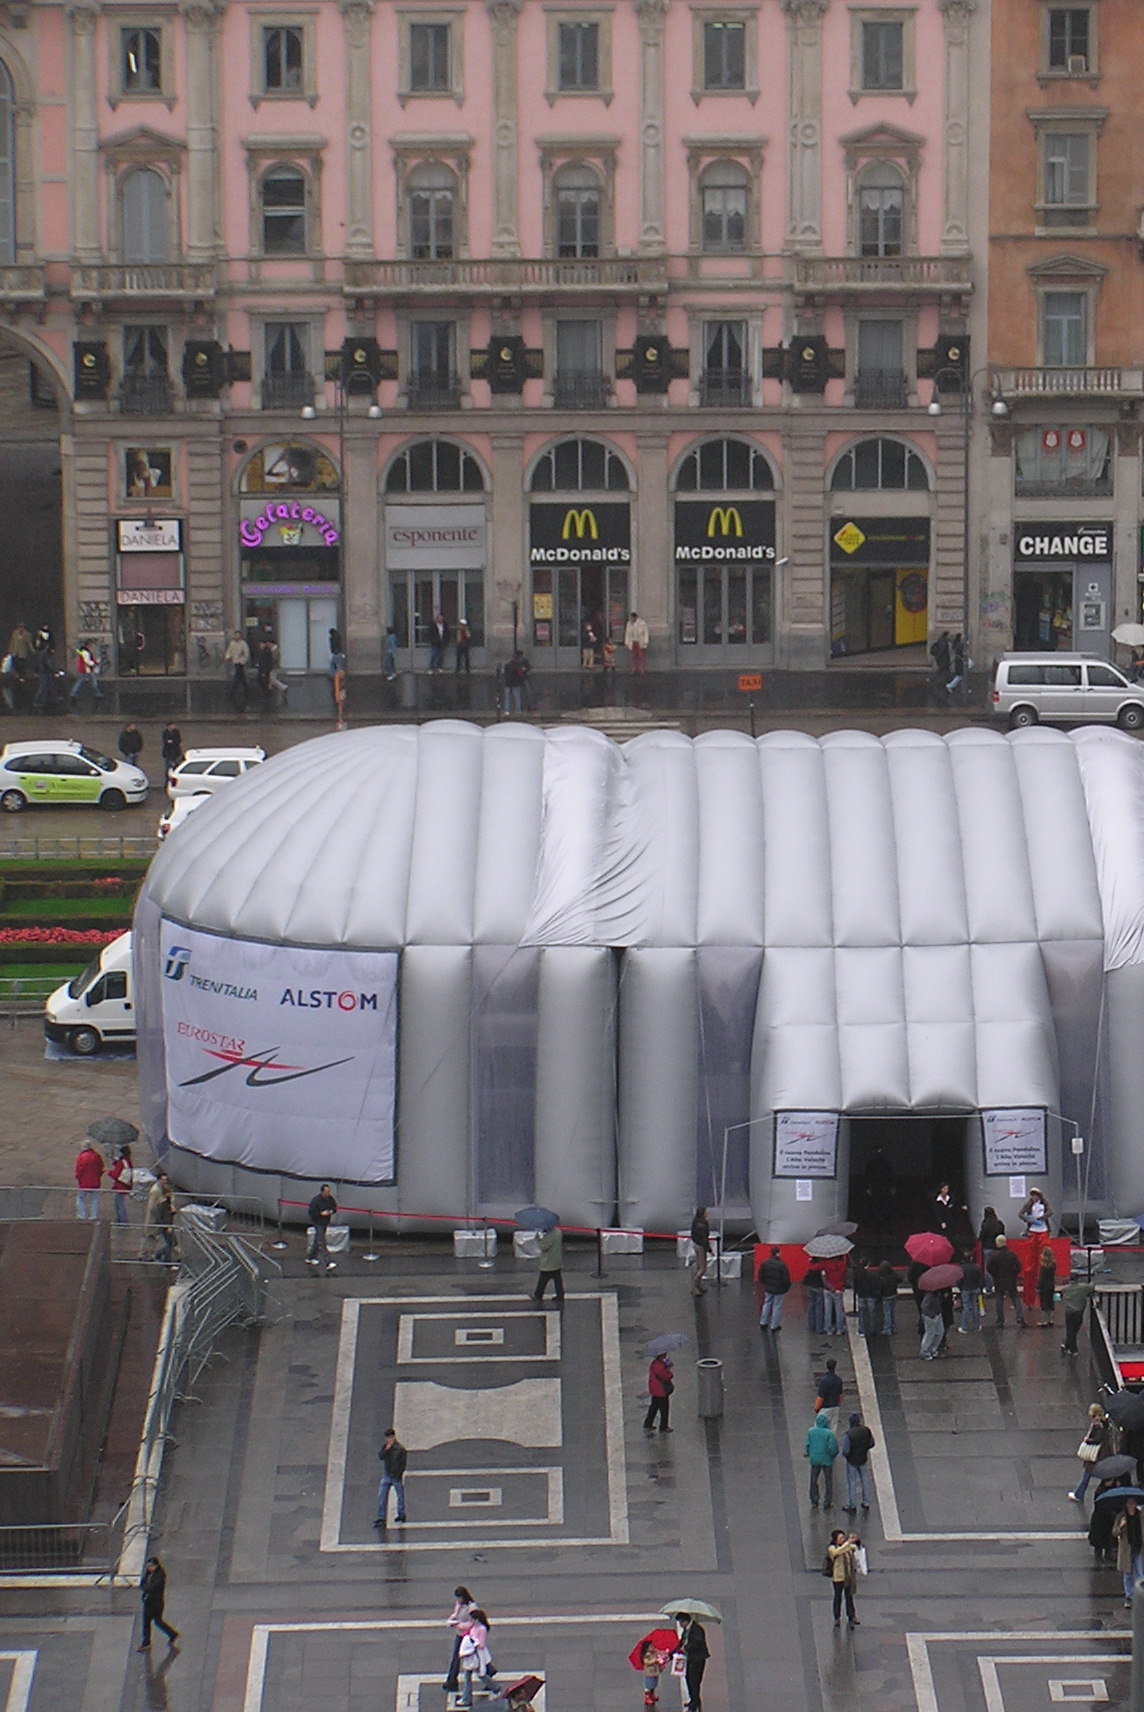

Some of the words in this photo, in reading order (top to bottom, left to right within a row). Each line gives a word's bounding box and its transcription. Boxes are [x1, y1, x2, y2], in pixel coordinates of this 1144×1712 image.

[240, 503, 339, 547] Gelateria
[122, 535, 177, 546] DANIELA
[393, 528, 478, 546] esponente
[1019, 536, 1108, 555] CHANGE
[531, 548, 630, 561] McDonald's
[675, 546, 775, 559] McDonald's
[122, 590, 180, 602] DANIELA
[189, 974, 259, 1001] TRENITALIA
[280, 988, 378, 1011] ALSTOM
[177, 1021, 246, 1052] EUROSTAR
